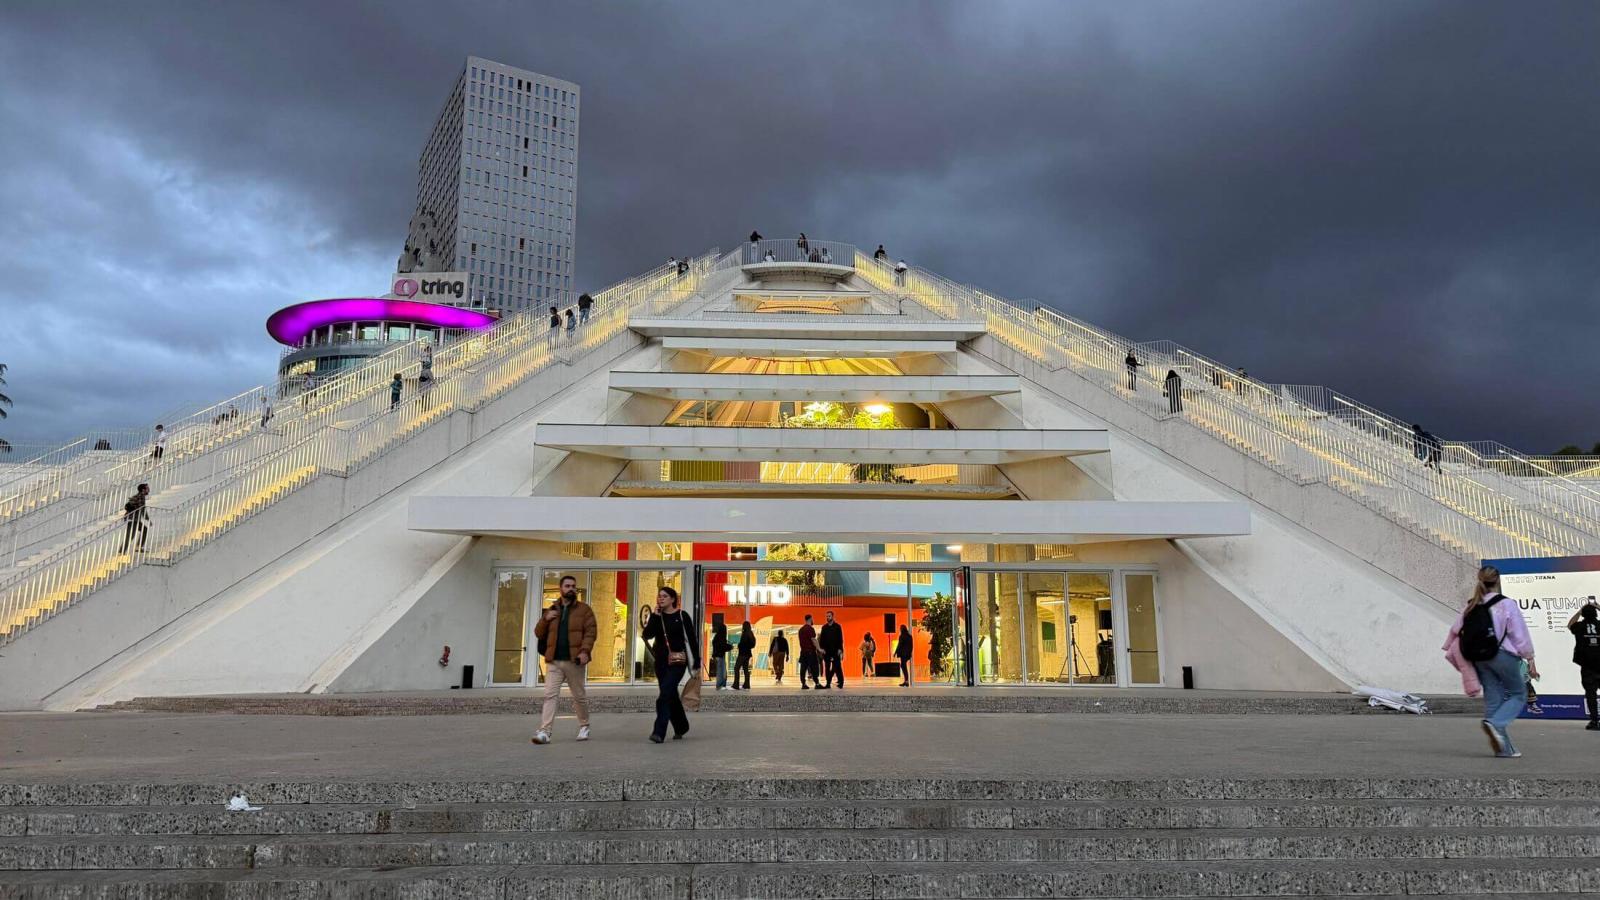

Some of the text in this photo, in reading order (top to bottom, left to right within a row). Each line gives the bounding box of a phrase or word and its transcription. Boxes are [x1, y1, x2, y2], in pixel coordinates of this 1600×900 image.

[421, 278, 464, 299] tring
[723, 585, 791, 605] TUMO
[1513, 597, 1591, 610] UA TUMO
